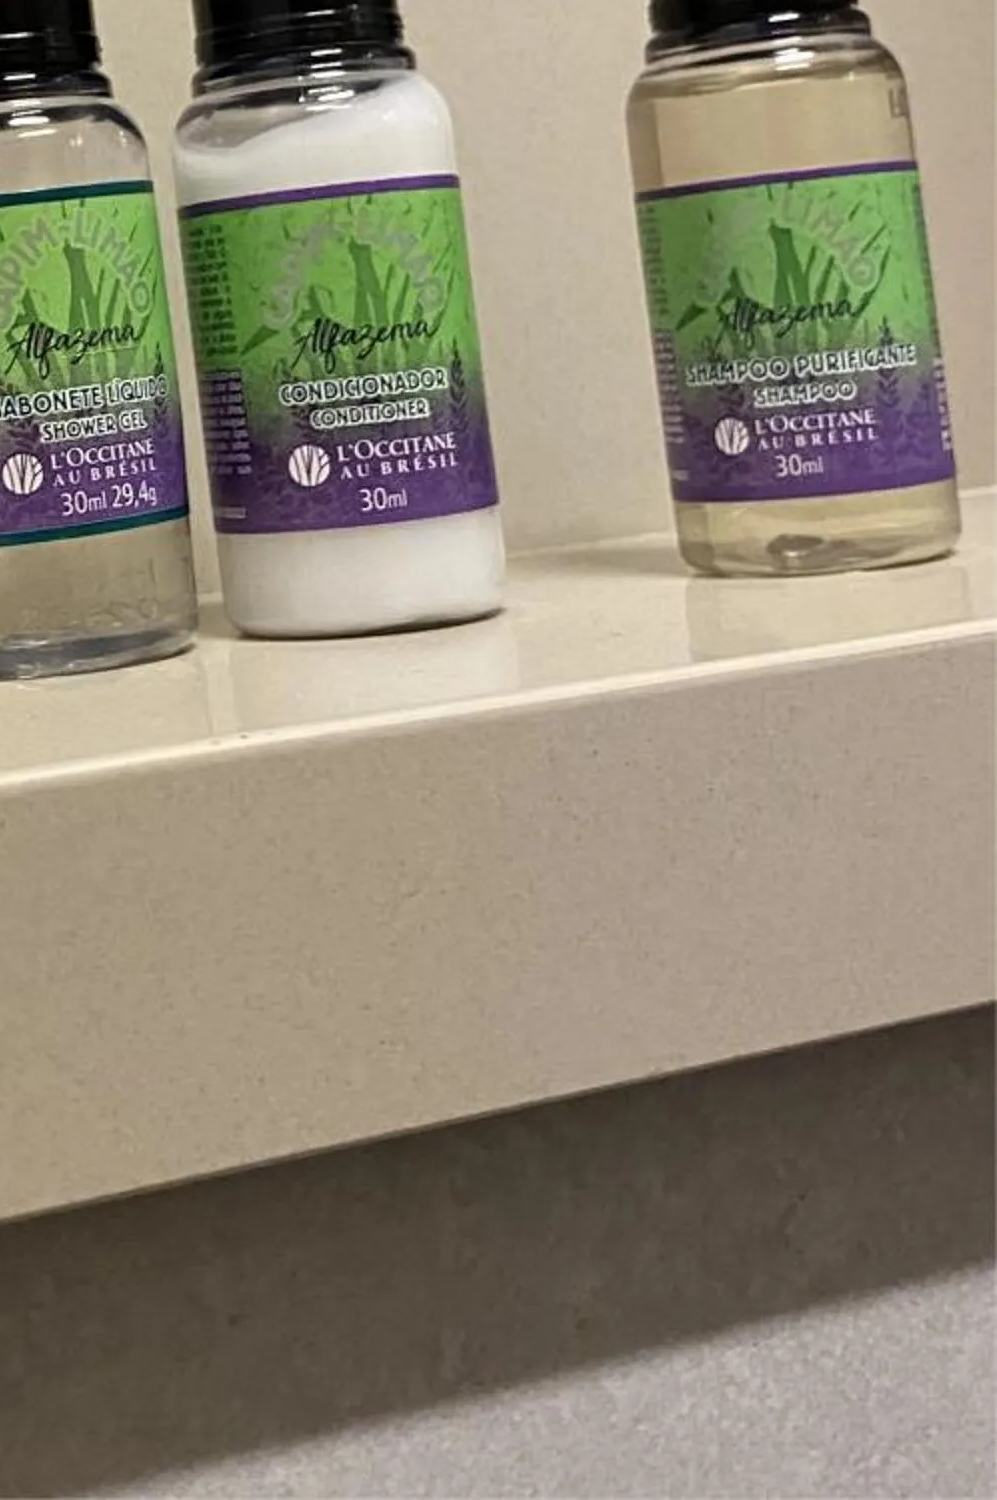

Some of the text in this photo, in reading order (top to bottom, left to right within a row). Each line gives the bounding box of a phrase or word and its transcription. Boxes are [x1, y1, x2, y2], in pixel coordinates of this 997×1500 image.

[5, 321, 141, 380] Alfazema
[290, 316, 433, 374] Alfazema
[279, 368, 449, 405] CONDICIONADOR
[753, 380, 858, 408] SHAMPOO
[41, 410, 147, 442] SHOWER GEL
[310, 398, 431, 430] CONDITIONER
[757, 436, 785, 451] AU
[53, 457, 157, 487] AU BRÉSIL
[340, 452, 459, 480] AU BRÉSIL
[775, 453, 824, 478] 30ml
[61, 479, 157, 516] 30ml 29,4g
[359, 487, 408, 512] 30ml
